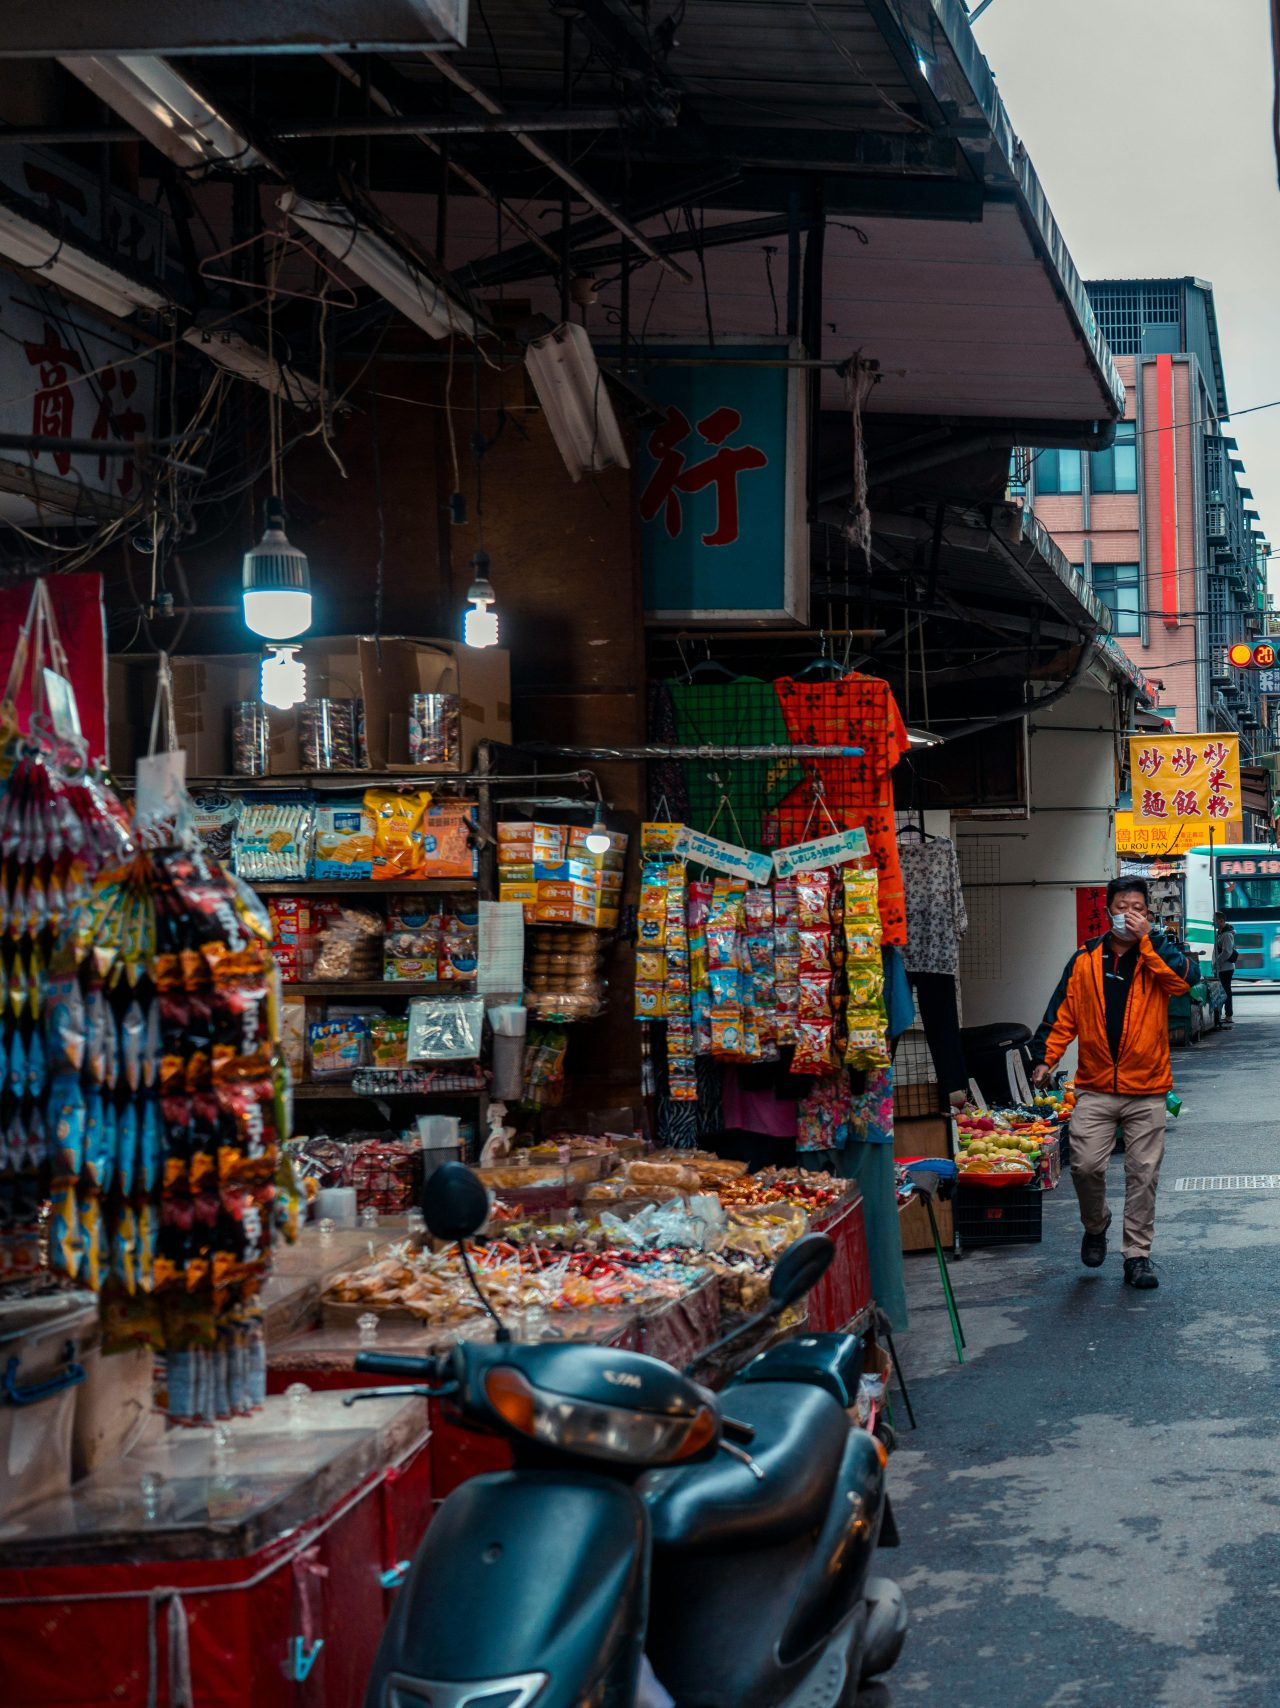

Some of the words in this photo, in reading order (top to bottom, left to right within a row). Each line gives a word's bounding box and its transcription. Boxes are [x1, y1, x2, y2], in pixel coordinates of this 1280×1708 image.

[640, 405, 768, 546] 行
[1257, 647, 1273, 663] 20
[1138, 748, 1169, 818] 炒麵
[1171, 747, 1202, 816] 炒飯
[1203, 742, 1234, 818] 炒米粉
[1221, 861, 1256, 874] FAB
